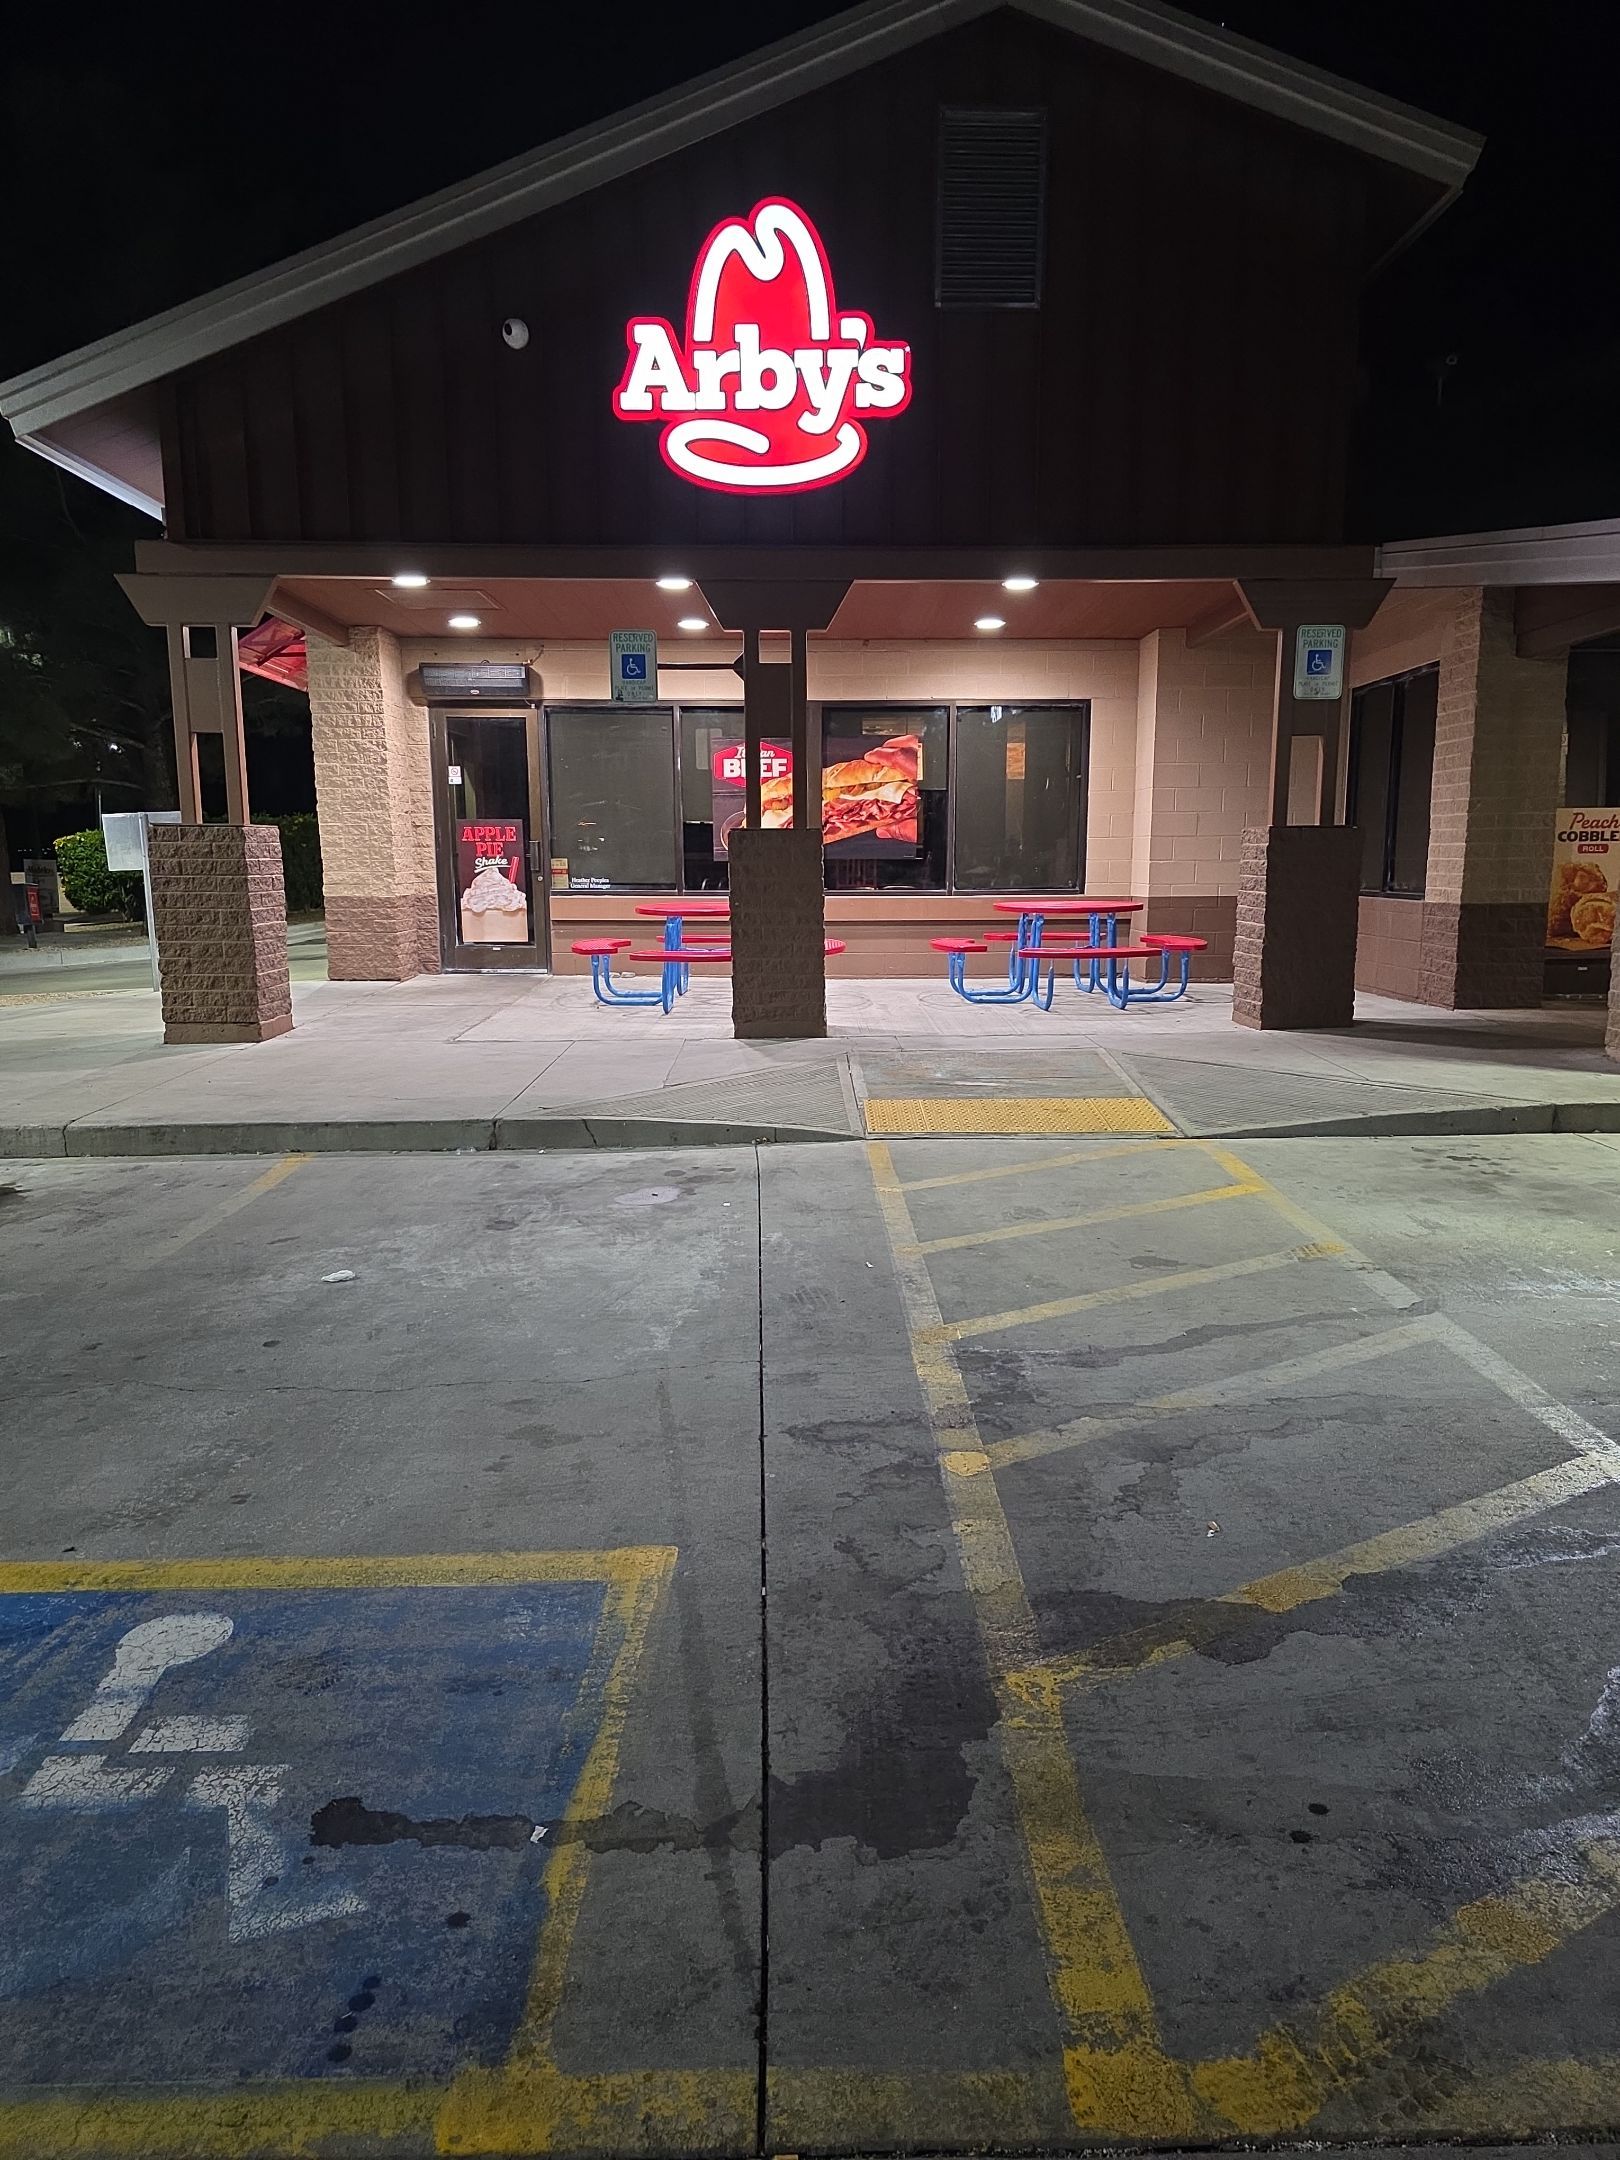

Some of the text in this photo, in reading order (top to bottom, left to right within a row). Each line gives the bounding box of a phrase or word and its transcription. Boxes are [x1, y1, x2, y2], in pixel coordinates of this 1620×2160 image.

[619, 317, 906, 435] Arby's
[612, 632, 654, 643] RESERVED
[1301, 628, 1342, 639] RESERVED
[615, 643, 651, 652] PARKING
[1303, 639, 1338, 648] PARKING
[1569, 812, 1620, 830] Peach
[461, 826, 517, 842] APPLE
[475, 842, 504, 857] PIE
[474, 855, 509, 869] Shake
